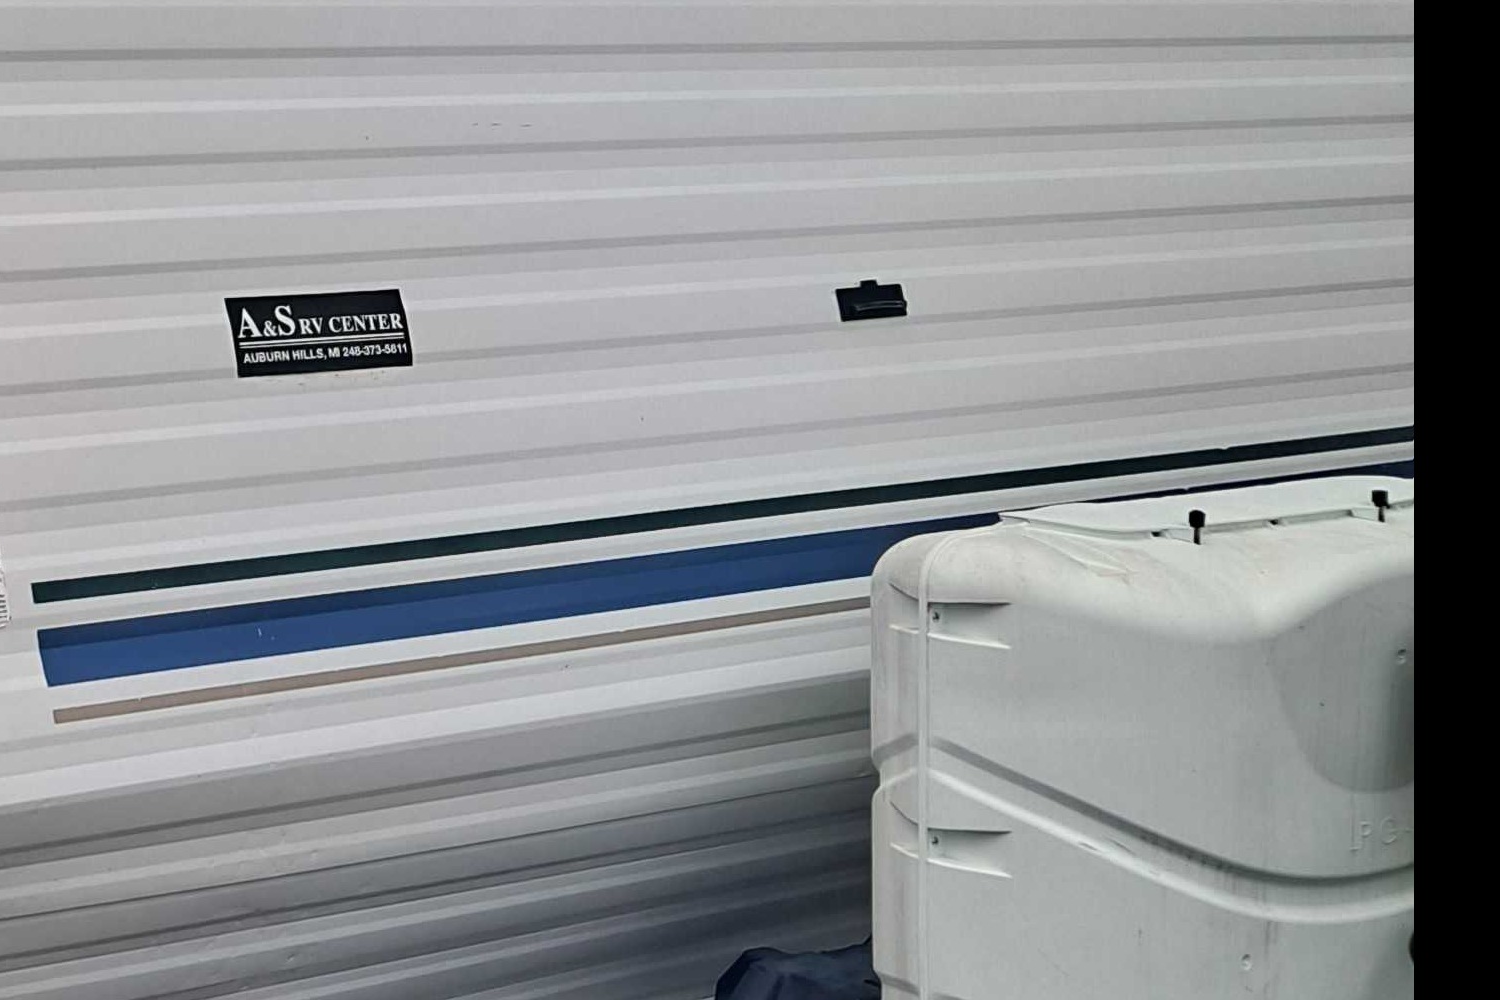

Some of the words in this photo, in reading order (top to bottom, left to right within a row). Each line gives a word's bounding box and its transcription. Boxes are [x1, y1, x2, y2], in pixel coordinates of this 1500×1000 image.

[237, 305, 296, 338] A&S
[298, 317, 323, 335] RV
[328, 313, 404, 333] CENTER
[243, 351, 290, 364] AUBURN
[292, 348, 327, 361] HILLS,
[328, 347, 341, 359] MI
